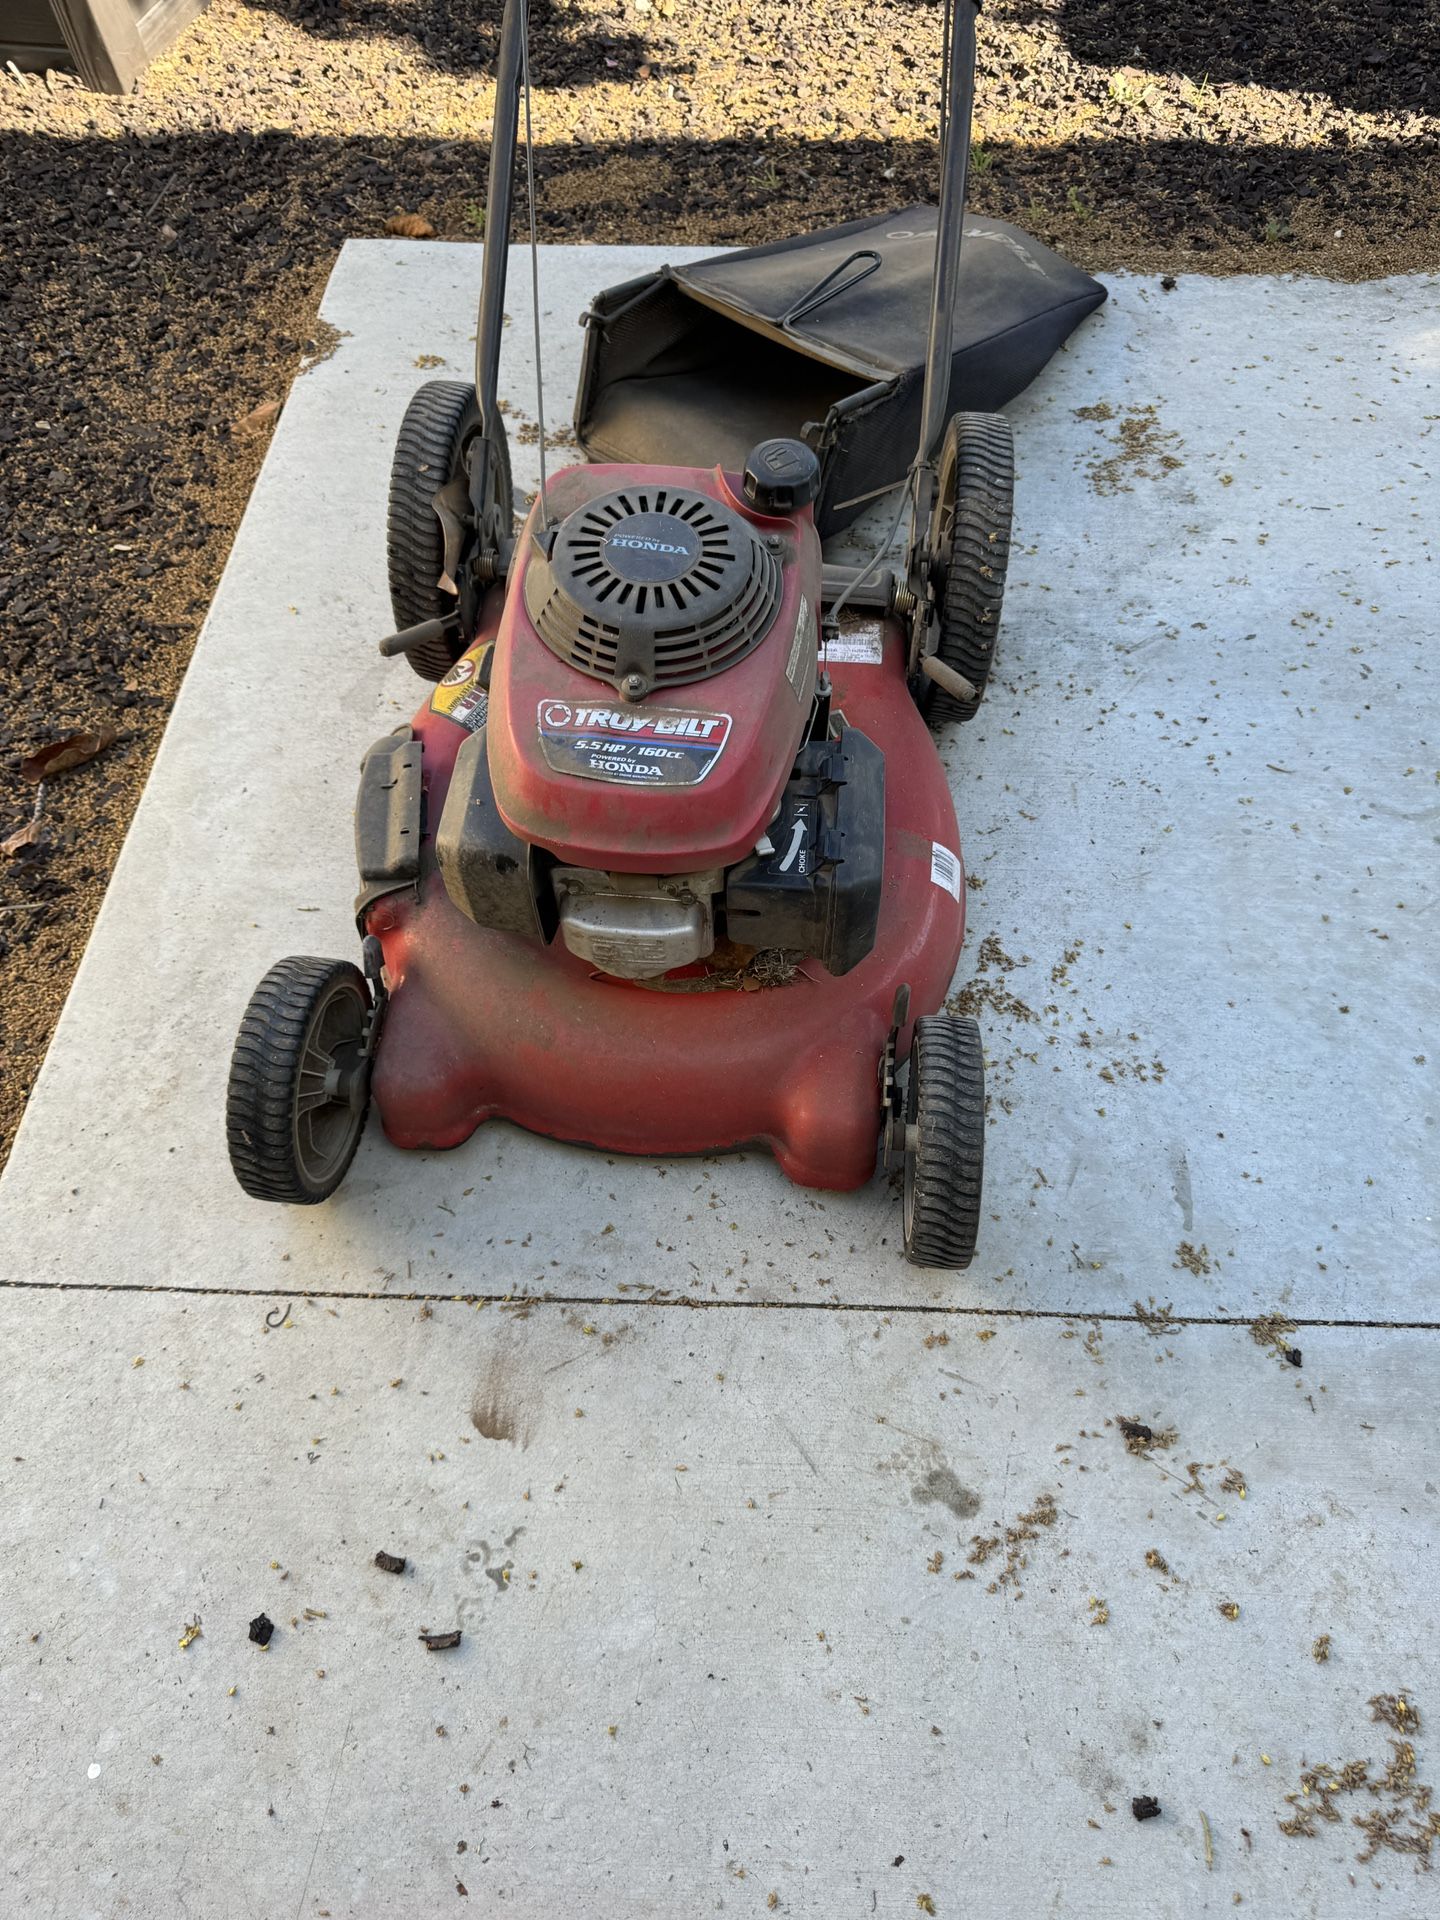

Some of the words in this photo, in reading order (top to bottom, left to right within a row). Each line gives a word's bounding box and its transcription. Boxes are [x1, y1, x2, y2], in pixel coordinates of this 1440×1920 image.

[611, 538, 689, 555] HONDA
[574, 708, 721, 738] TROY-BILT
[574, 740, 601, 750] 5.5
[601, 742, 627, 753] HP
[637, 746, 685, 760] 160cc
[590, 753, 627, 763] POWERED
[627, 757, 636, 765] by
[588, 759, 664, 777] HONDA
